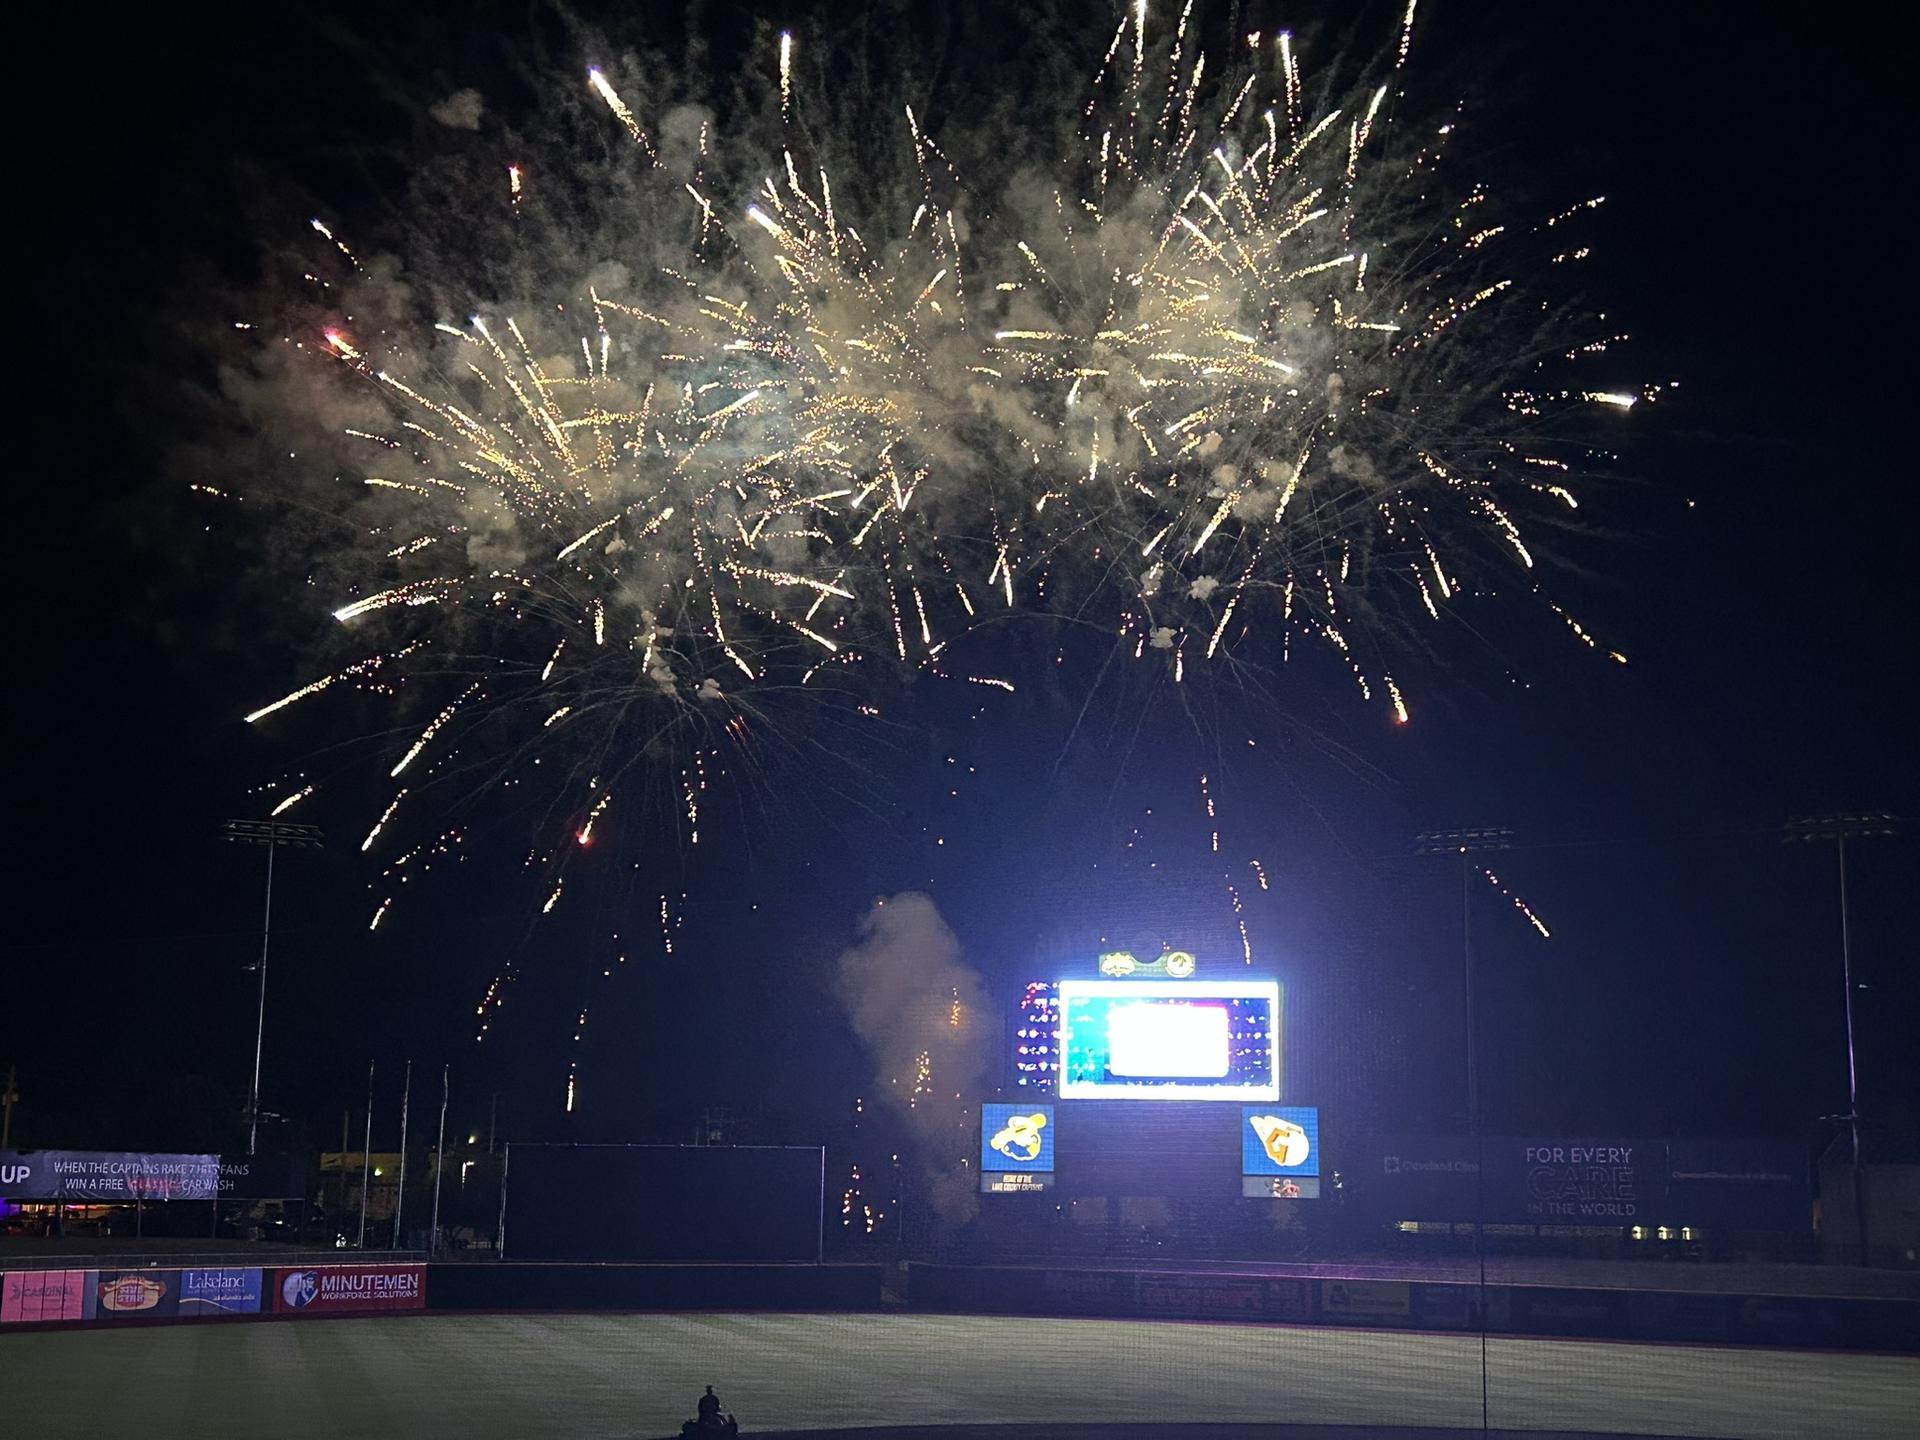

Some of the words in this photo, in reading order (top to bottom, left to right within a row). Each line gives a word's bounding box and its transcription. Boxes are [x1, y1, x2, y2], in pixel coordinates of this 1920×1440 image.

[1526, 1147, 1565, 1163] FOR
[1571, 1147, 1633, 1163] EVERY
[1, 1165, 31, 1184] UP
[54, 1161, 86, 1174] WHEN
[88, 1162, 108, 1174] THE
[110, 1162, 159, 1175] CAPTAINS
[161, 1163, 186, 1175] RAKE
[220, 1164, 250, 1176] FANS
[65, 1178, 87, 1190] WIN
[88, 1178, 96, 1190] A
[99, 1178, 123, 1190] FREE
[181, 1179, 201, 1191] CAR
[203, 1179, 234, 1191] WASH
[1528, 1165, 1636, 1200] CARE
[1527, 1202, 1543, 1215] IN
[1547, 1202, 1576, 1216] THE
[1580, 1203, 1636, 1217] WORLD
[188, 1271, 245, 1289] Lakeland
[321, 1273, 418, 1291] MINUTEMEN
[321, 1290, 371, 1300] WORKFORCE
[373, 1289, 418, 1298] SOLUTIONS
